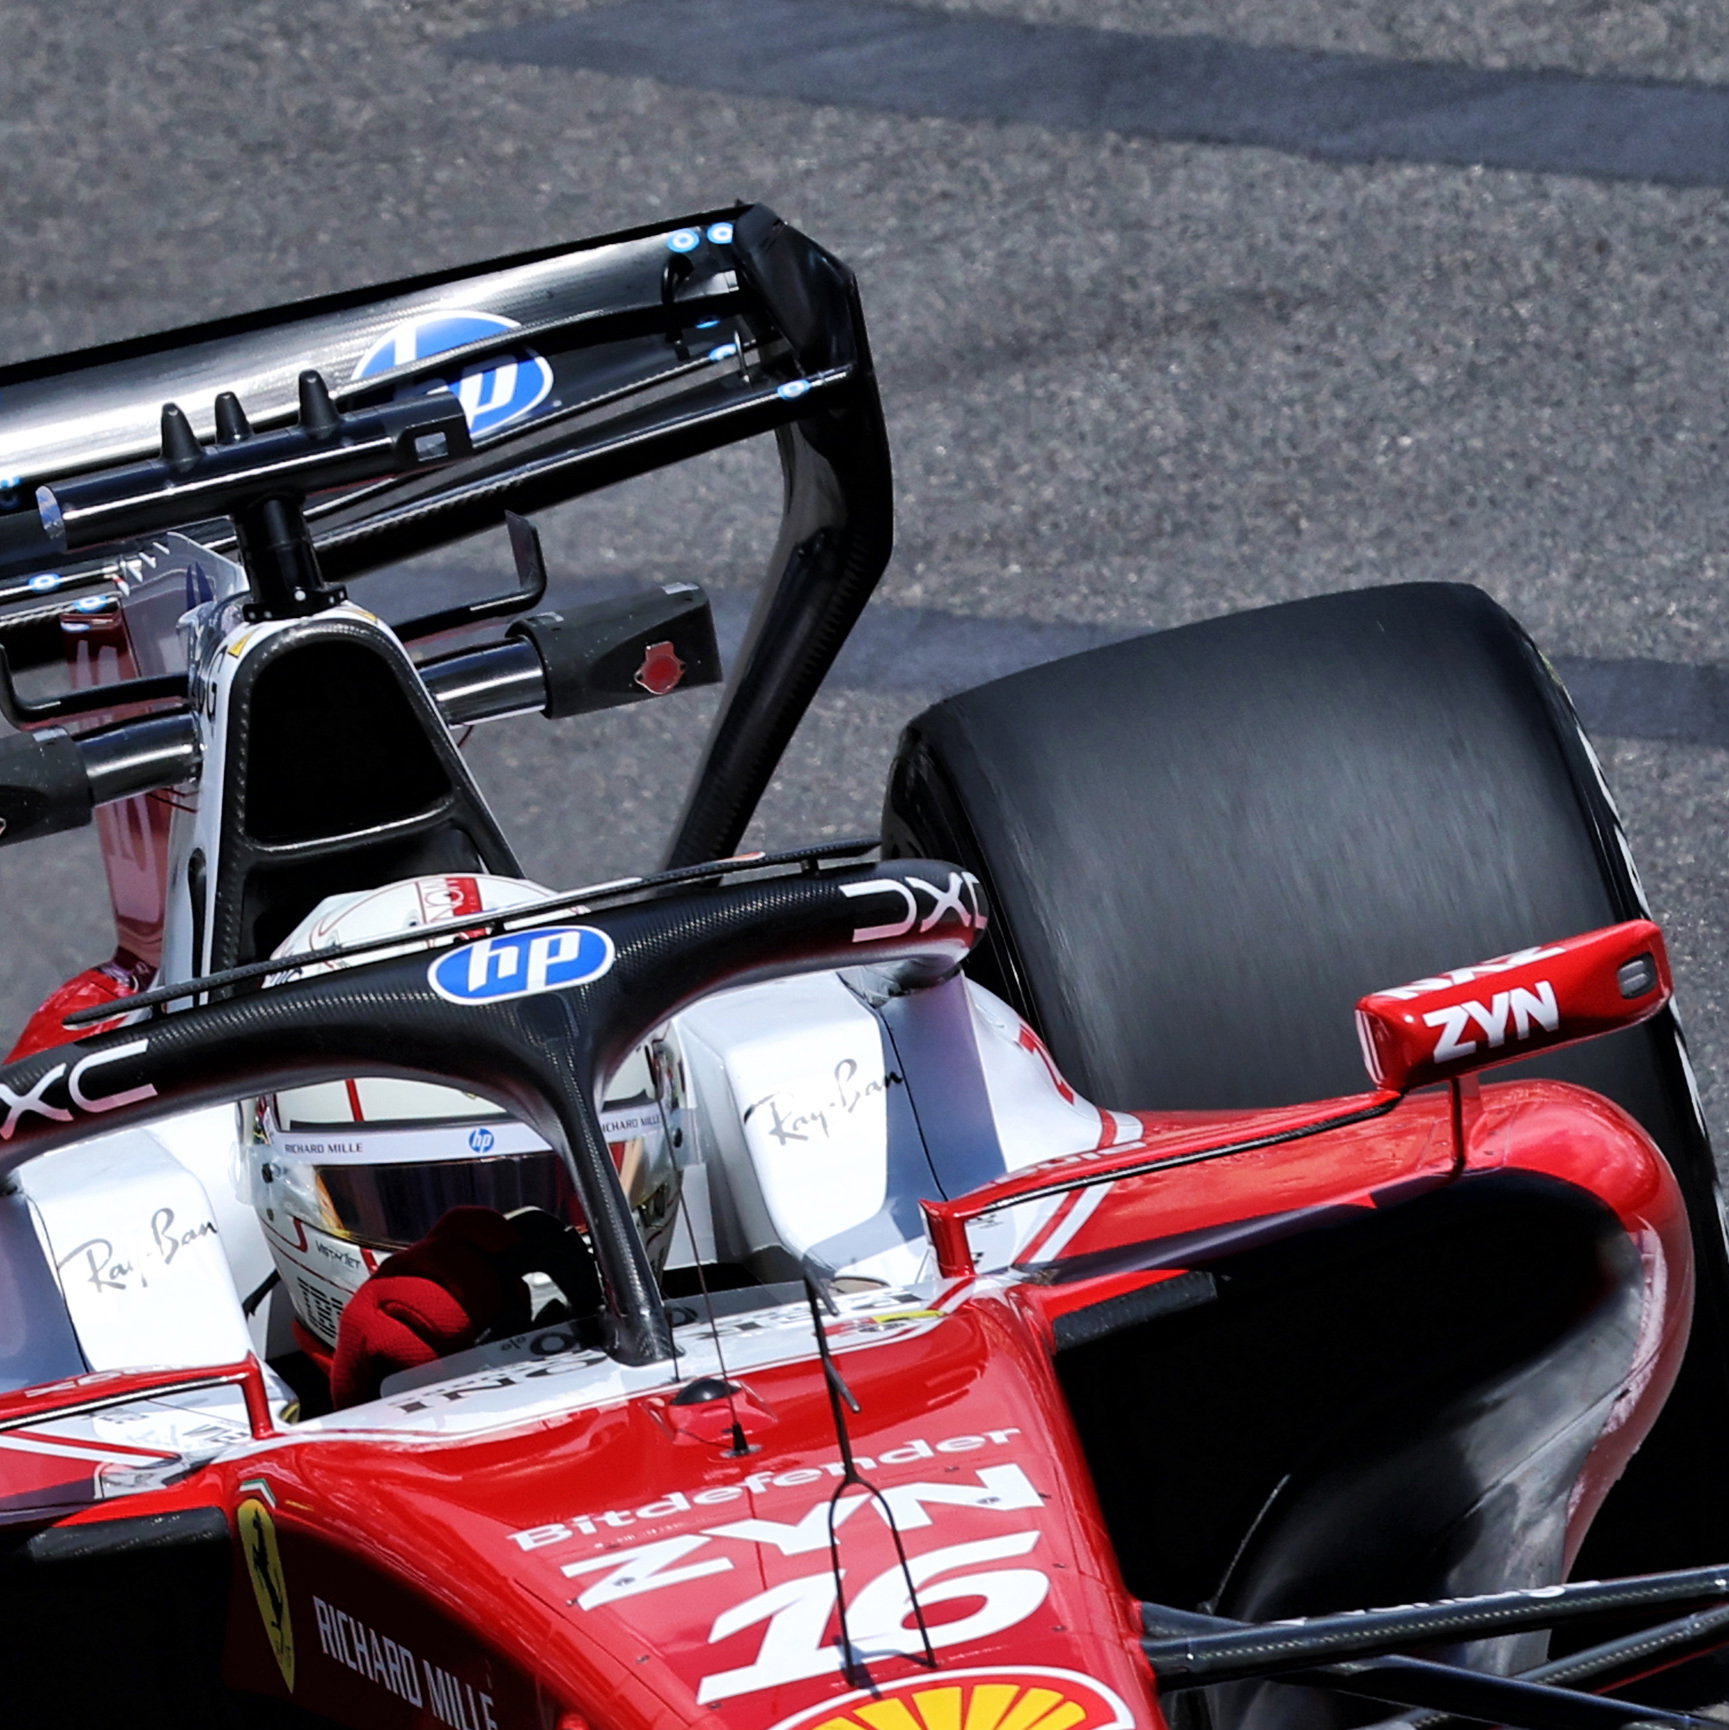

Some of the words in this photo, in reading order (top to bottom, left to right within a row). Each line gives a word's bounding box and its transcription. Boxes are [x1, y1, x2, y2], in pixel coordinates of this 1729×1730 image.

[467, 930, 582, 992] hp
[1424, 979, 1560, 1064] ZYN
[284, 1142, 325, 1155] RICHARD
[327, 1141, 364, 1154] MILLE
[601, 1118, 639, 1134] ICHARD
[506, 1427, 1022, 1551] Bitdefender
[560, 1463, 1046, 1612] ZYN
[312, 1595, 423, 1709] RICHARD
[696, 1530, 1050, 1705] 16
